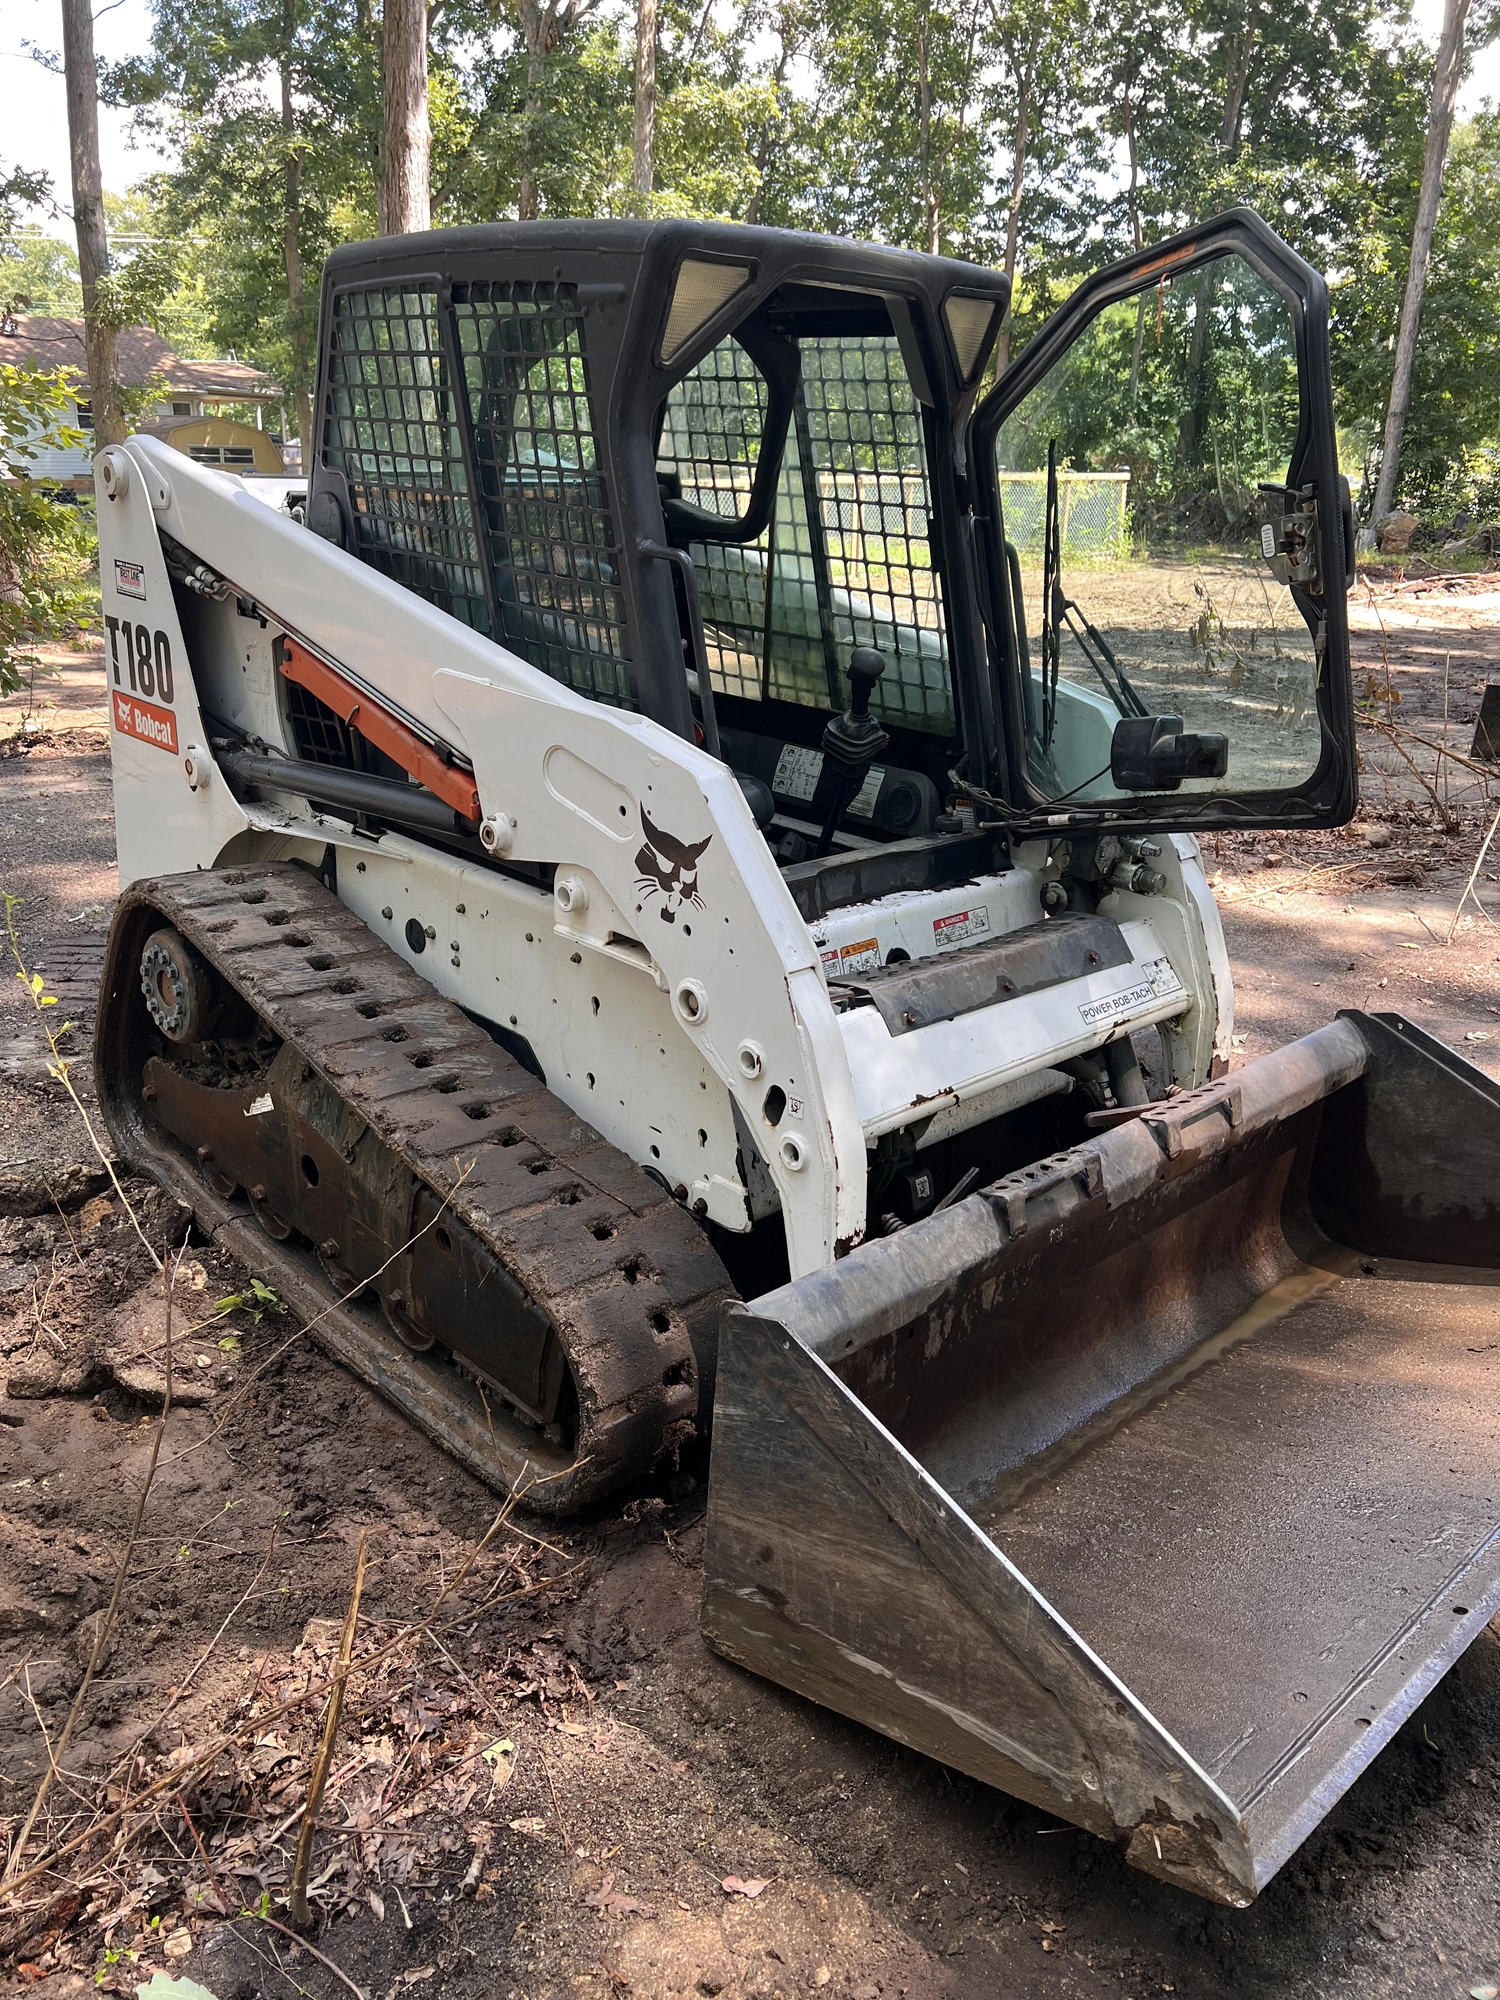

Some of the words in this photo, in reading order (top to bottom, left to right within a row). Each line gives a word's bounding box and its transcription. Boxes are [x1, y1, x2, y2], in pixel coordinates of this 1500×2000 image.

[105, 615, 174, 704] T180
[134, 708, 173, 746] Bobcat
[851, 940, 875, 952] WARNING
[1083, 1002, 1114, 1019] POWER
[1112, 986, 1152, 1008] BOB-TACH
